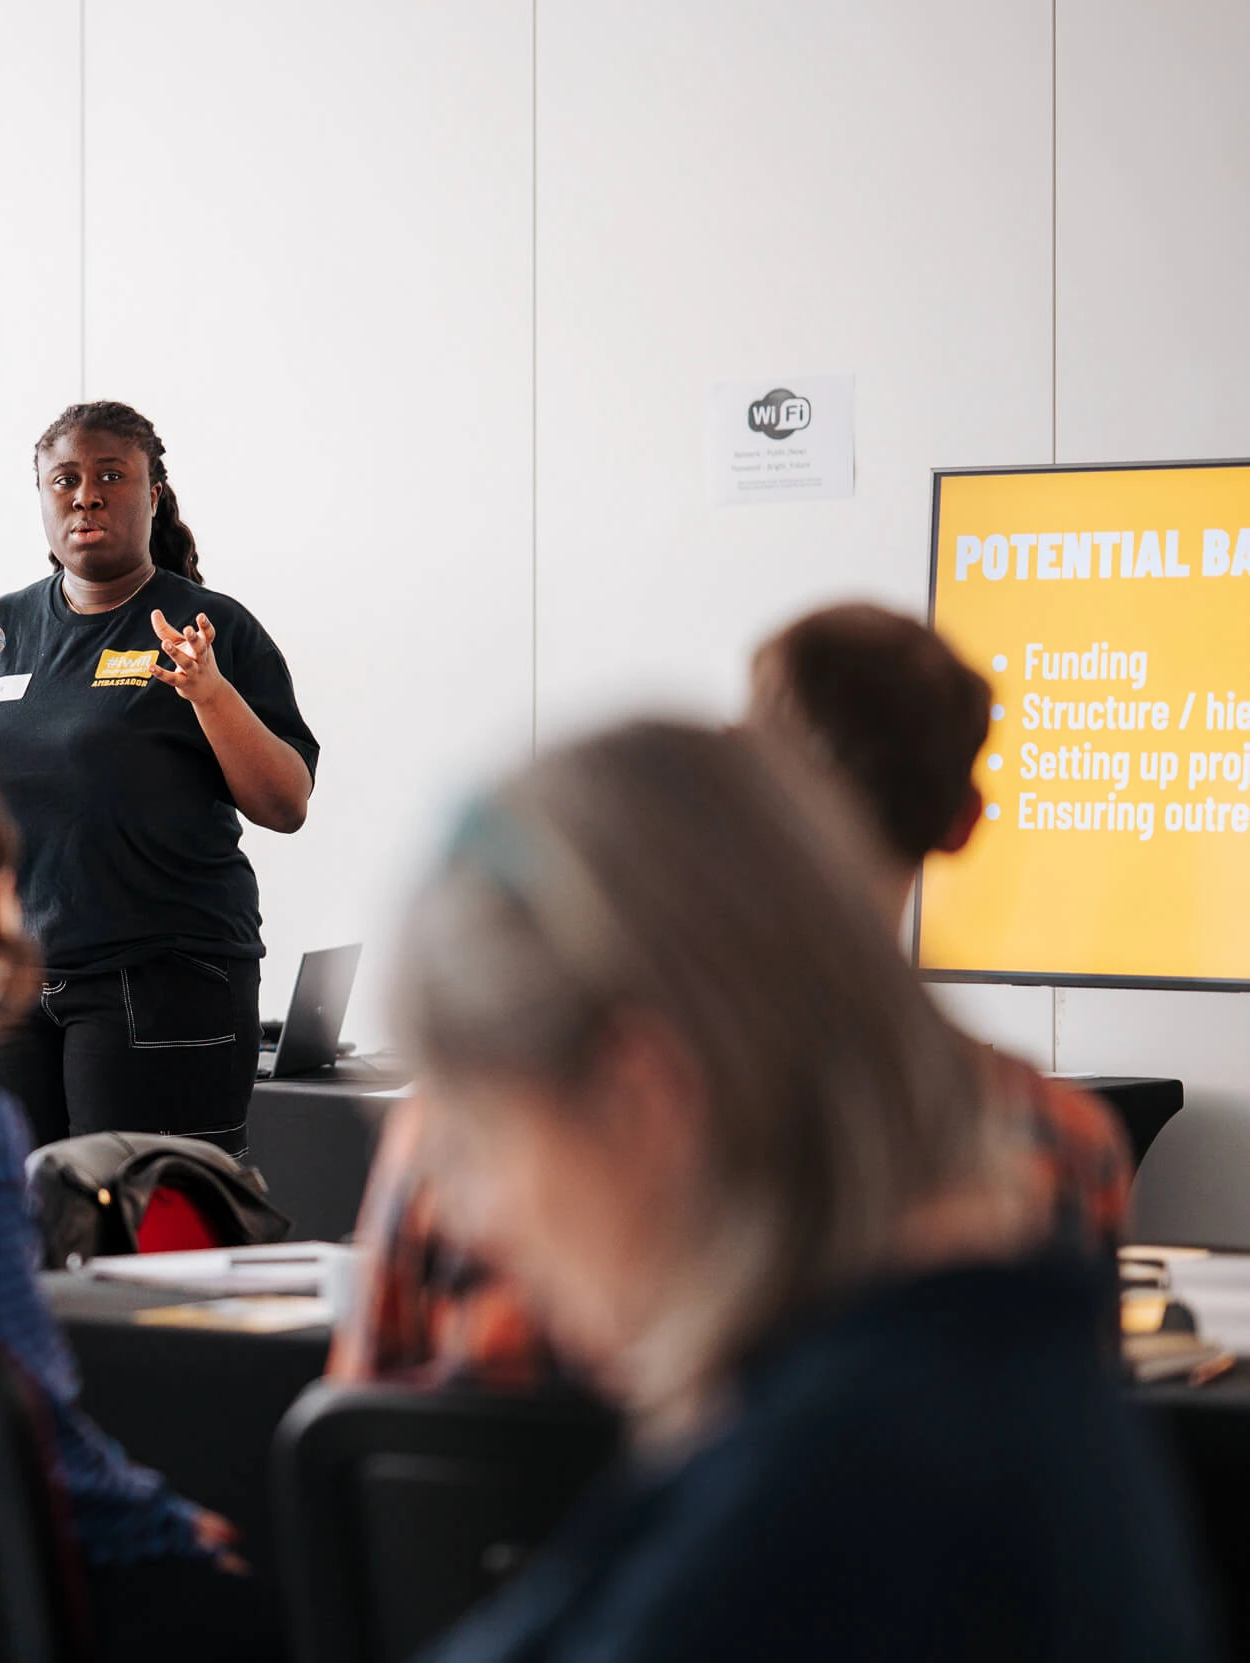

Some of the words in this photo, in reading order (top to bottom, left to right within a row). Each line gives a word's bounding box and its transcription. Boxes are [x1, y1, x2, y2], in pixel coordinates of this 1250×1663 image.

[954, 530, 1190, 580] POTENTIAL
[90, 678, 149, 688] AMBASSADOR
[1025, 641, 1147, 690] Funding
[1022, 692, 1170, 730] Structure
[1178, 692, 1197, 730] /
[1020, 742, 1130, 790] Setting
[1140, 752, 1178, 790] up
[1188, 742, 1250, 791] proj
[1018, 792, 1154, 841] Ensuring
[1165, 796, 1250, 833] outre
